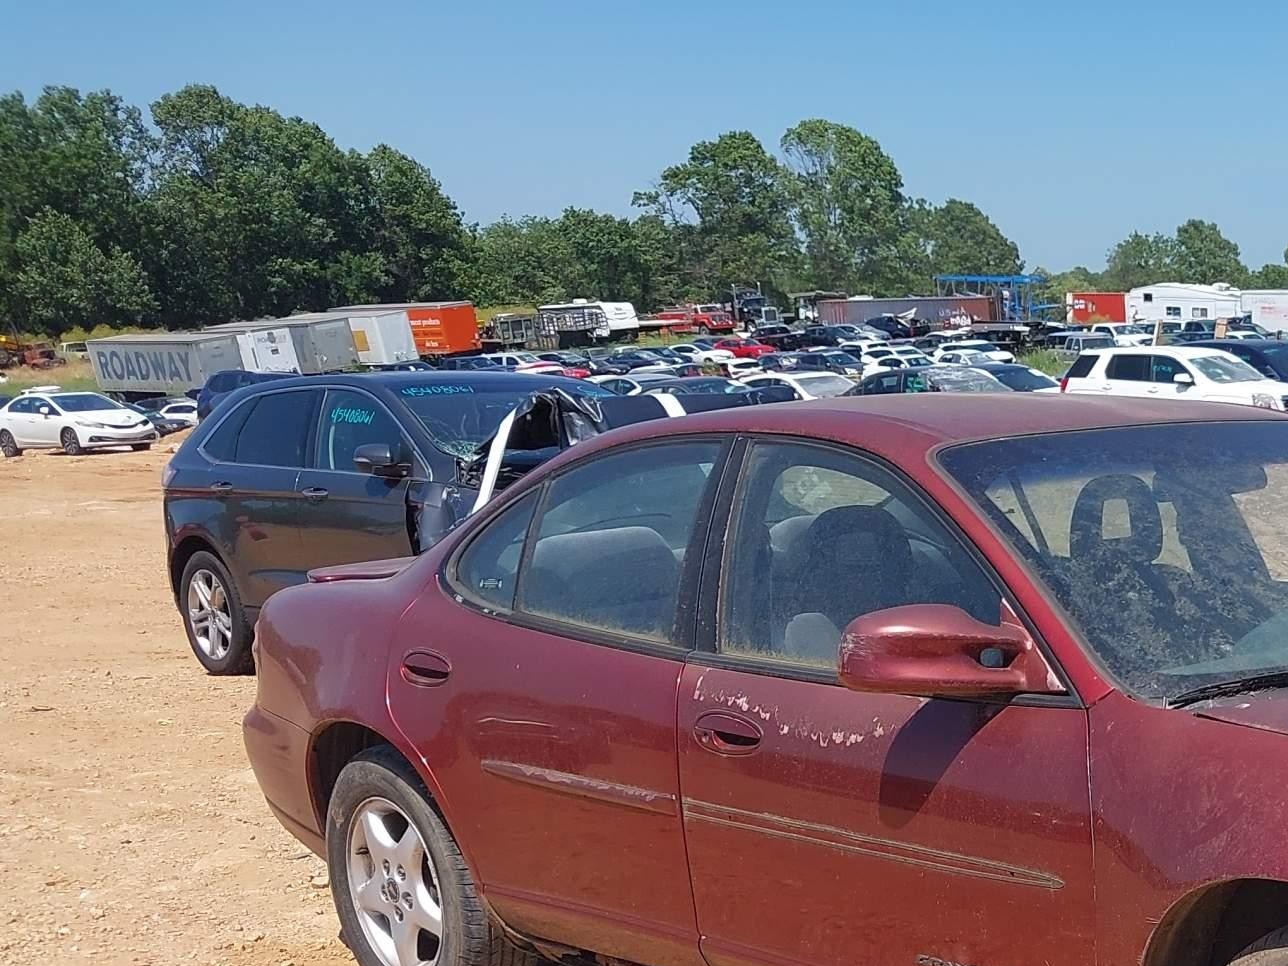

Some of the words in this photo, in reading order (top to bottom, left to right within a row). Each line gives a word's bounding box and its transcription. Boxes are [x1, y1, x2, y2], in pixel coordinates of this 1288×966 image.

[96, 350, 193, 382] ROADWAY
[401, 385, 475, 397] 45408061
[331, 407, 376, 425] 45408061
